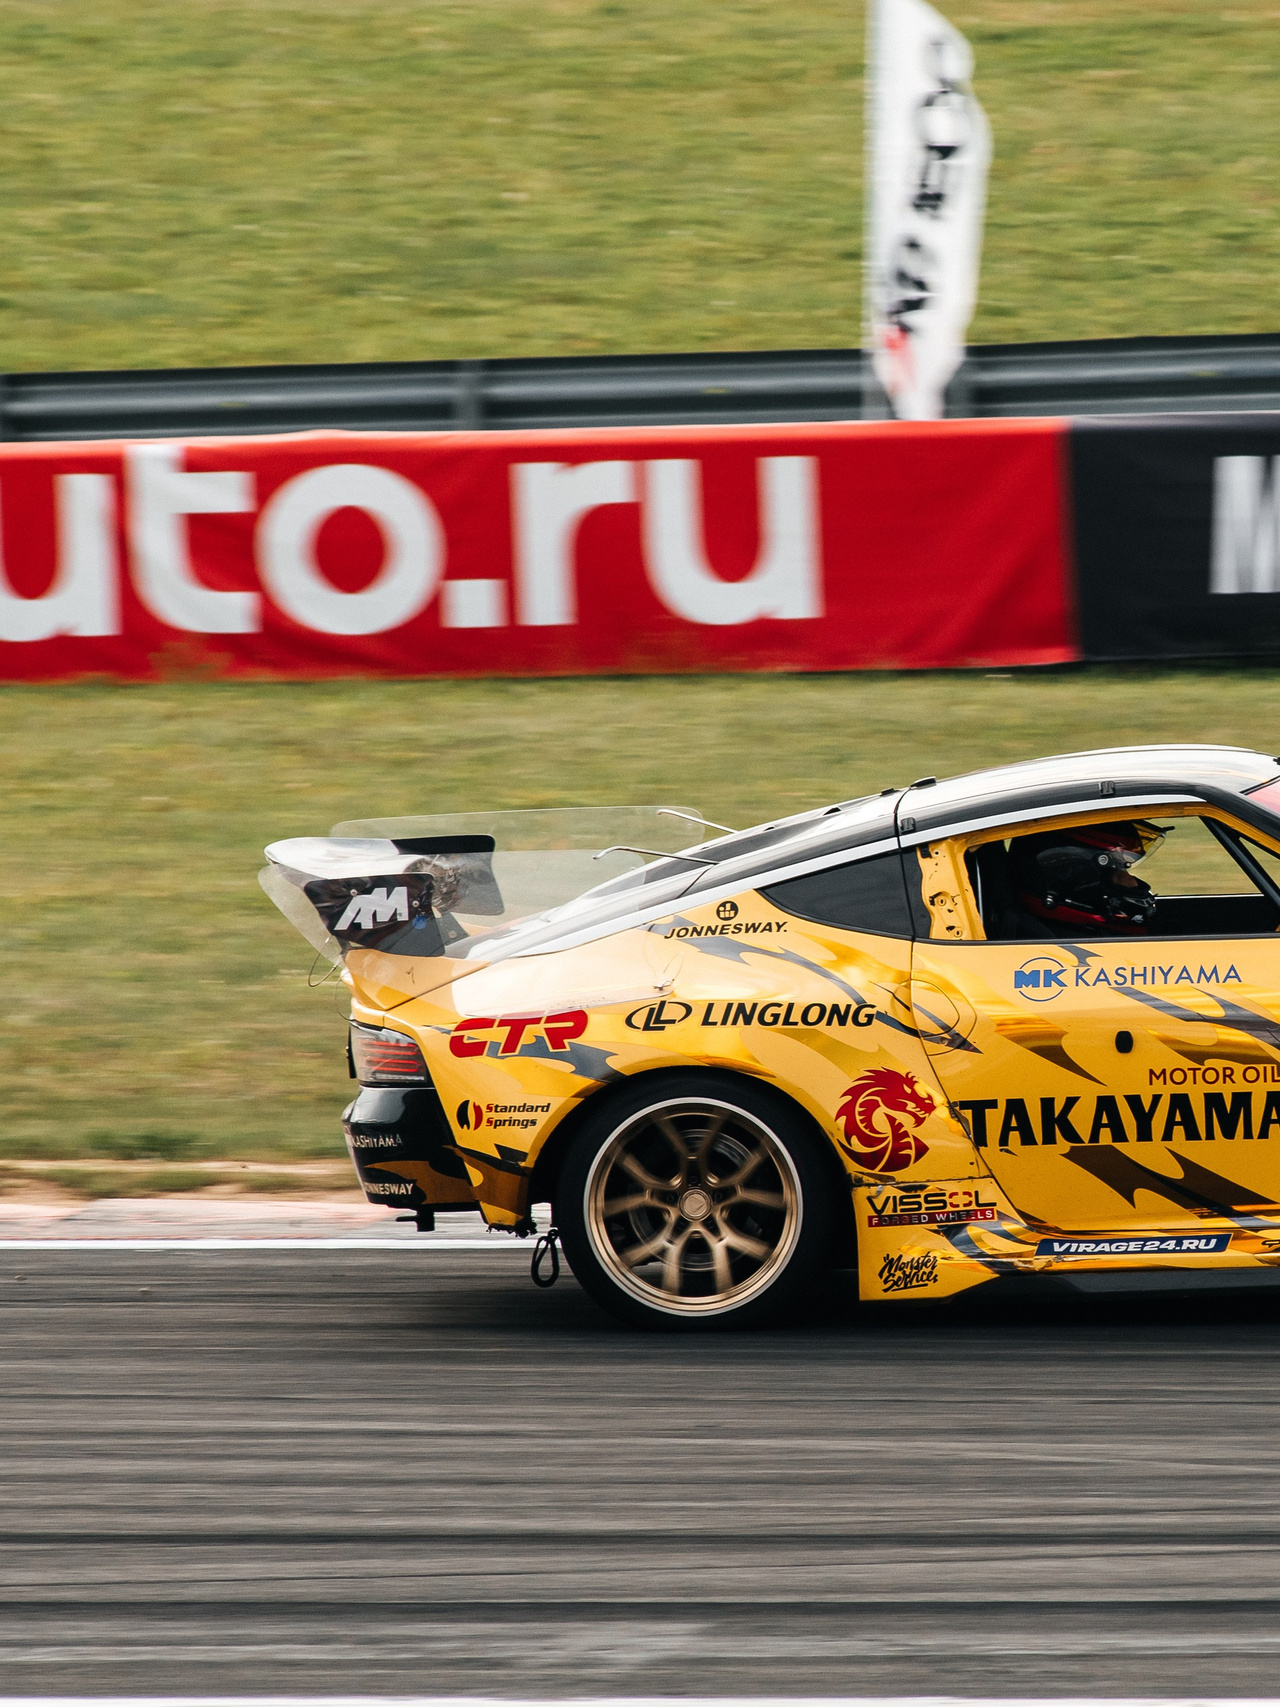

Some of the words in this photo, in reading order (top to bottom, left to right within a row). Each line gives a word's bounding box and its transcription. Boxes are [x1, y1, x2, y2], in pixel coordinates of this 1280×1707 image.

[1013, 967, 1069, 989] MK
[1074, 964, 1243, 987] KASHIYAMA
[700, 1002, 877, 1027] LINGLONG
[449, 1009, 589, 1058] CTR
[1148, 1067, 1236, 1086] MOTOR
[485, 1103, 551, 1114] Standard
[485, 1116, 538, 1129] Springs
[866, 1190, 998, 1215] VISSOL
[935, 1210, 993, 1221] WHEELS
[1052, 1238, 1217, 1253] VIRAGE24.RU
